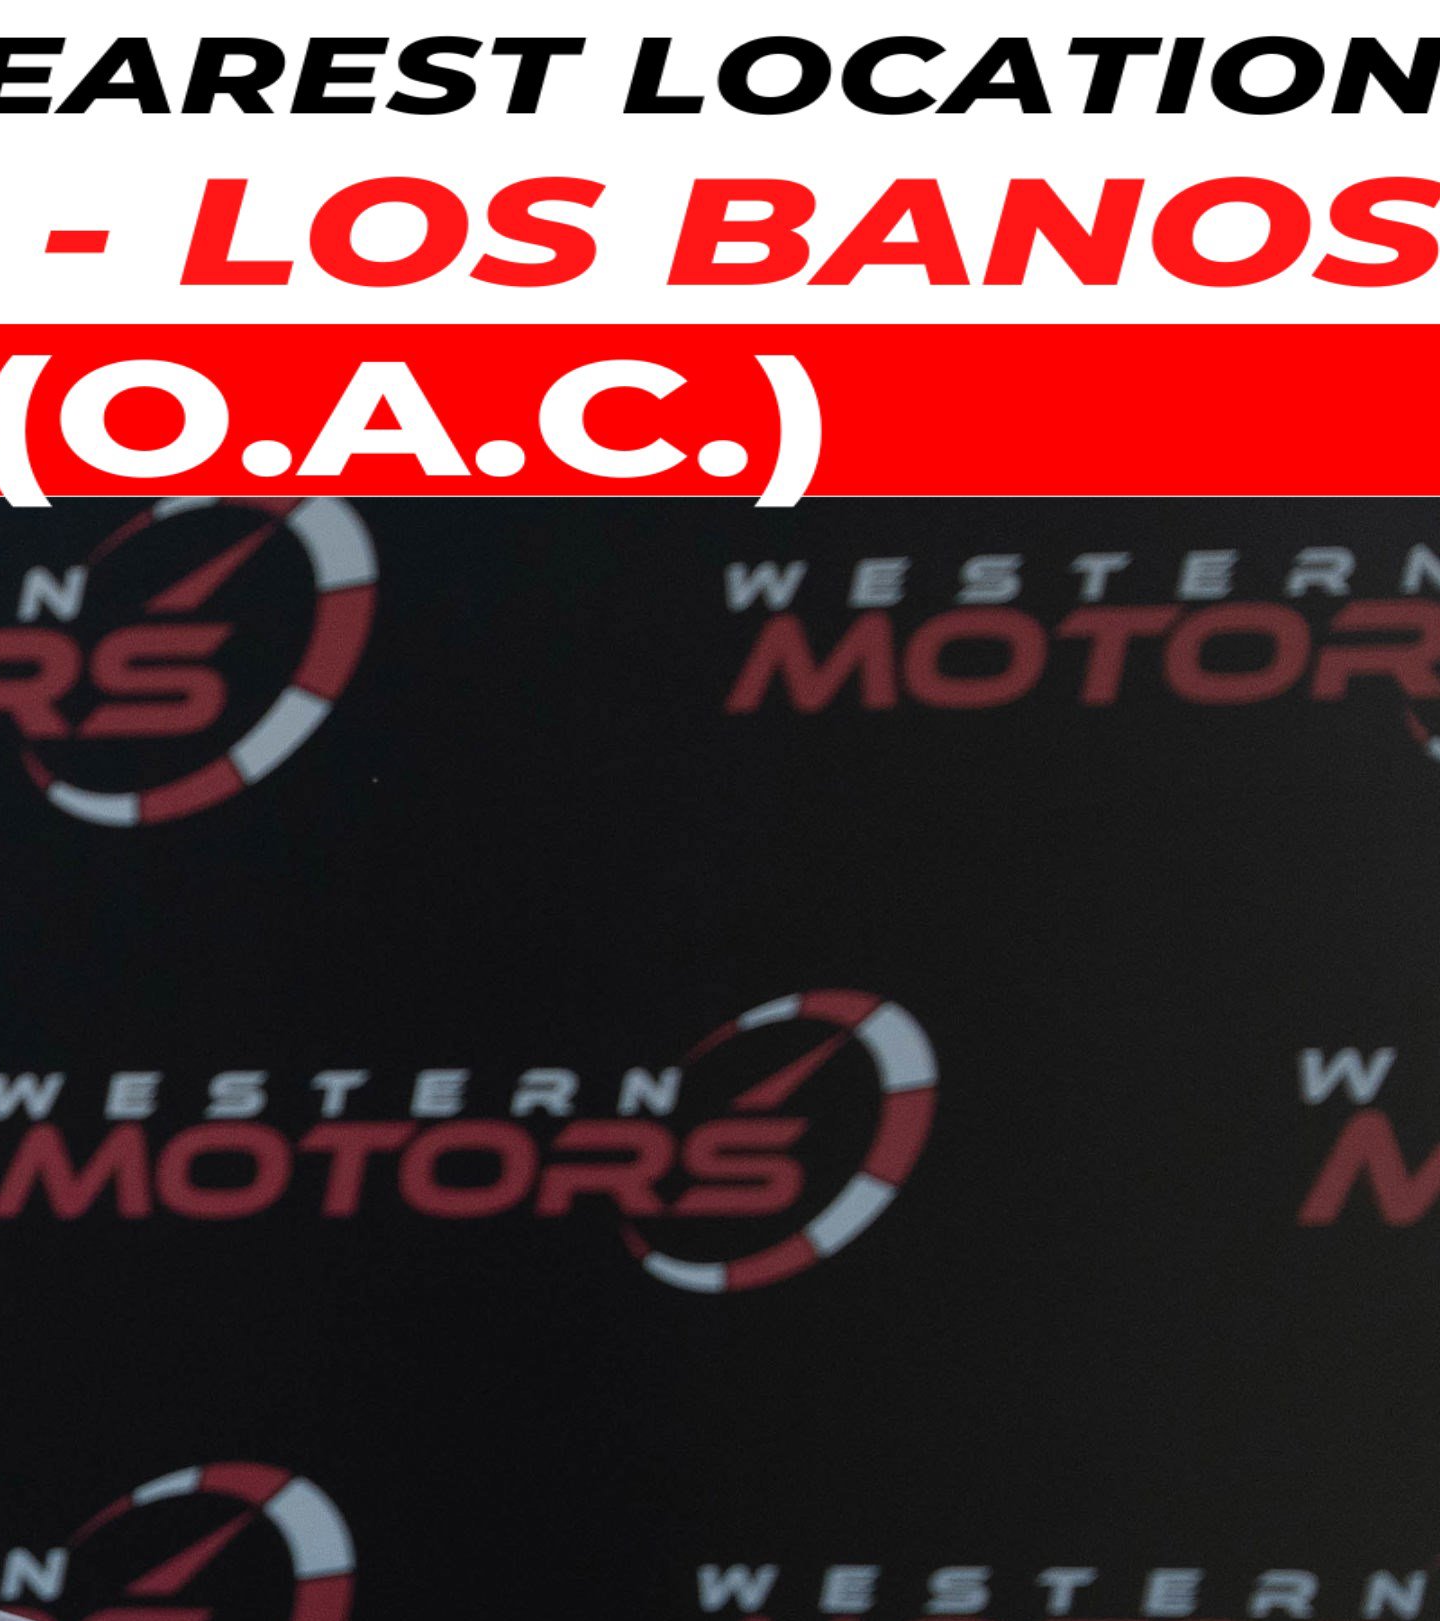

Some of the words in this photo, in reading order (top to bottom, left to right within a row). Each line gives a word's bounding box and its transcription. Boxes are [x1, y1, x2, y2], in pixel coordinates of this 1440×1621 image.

[728, 545, 1440, 609] WESTERN
[727, 600, 1440, 712] MOTOR
[698, 1565, 1428, 1619] WESTERN
